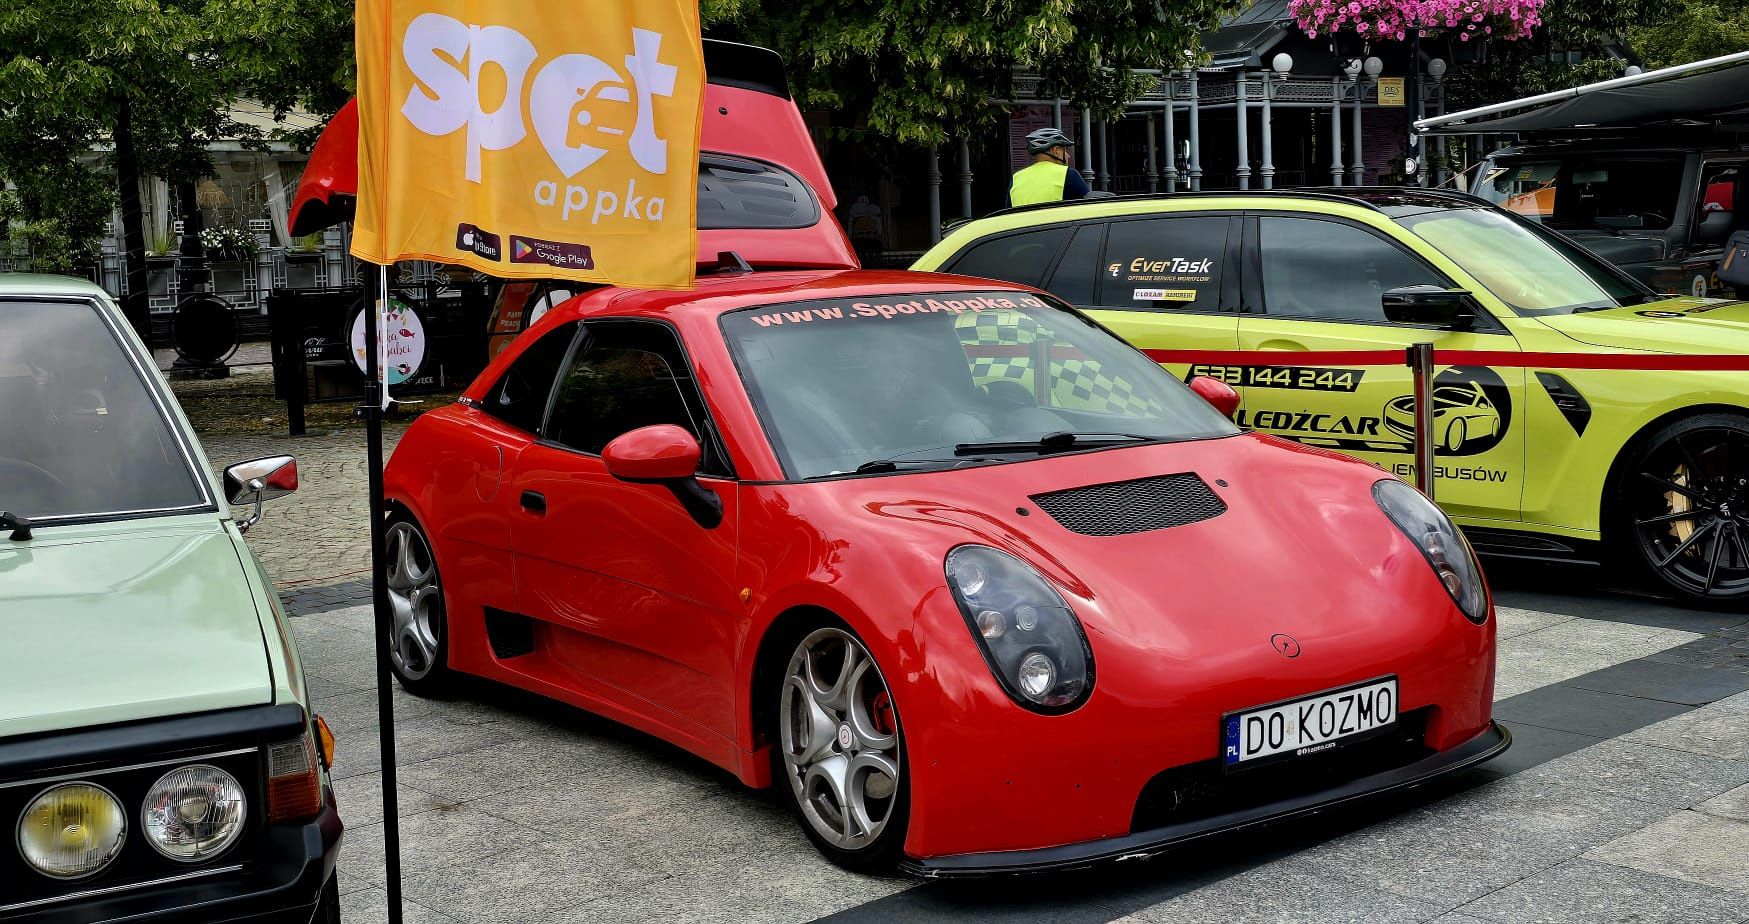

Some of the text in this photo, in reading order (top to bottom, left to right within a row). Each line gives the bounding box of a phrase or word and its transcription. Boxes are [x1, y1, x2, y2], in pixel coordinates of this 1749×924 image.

[534, 179, 665, 225] appka
[536, 248, 588, 267] Google Play
[1130, 257, 1213, 273] EverTask
[1194, 366, 1354, 390] 533 144 244
[1434, 466, 1507, 482] BUSÓW
[1227, 687, 1392, 757] PL DO KOZMO
